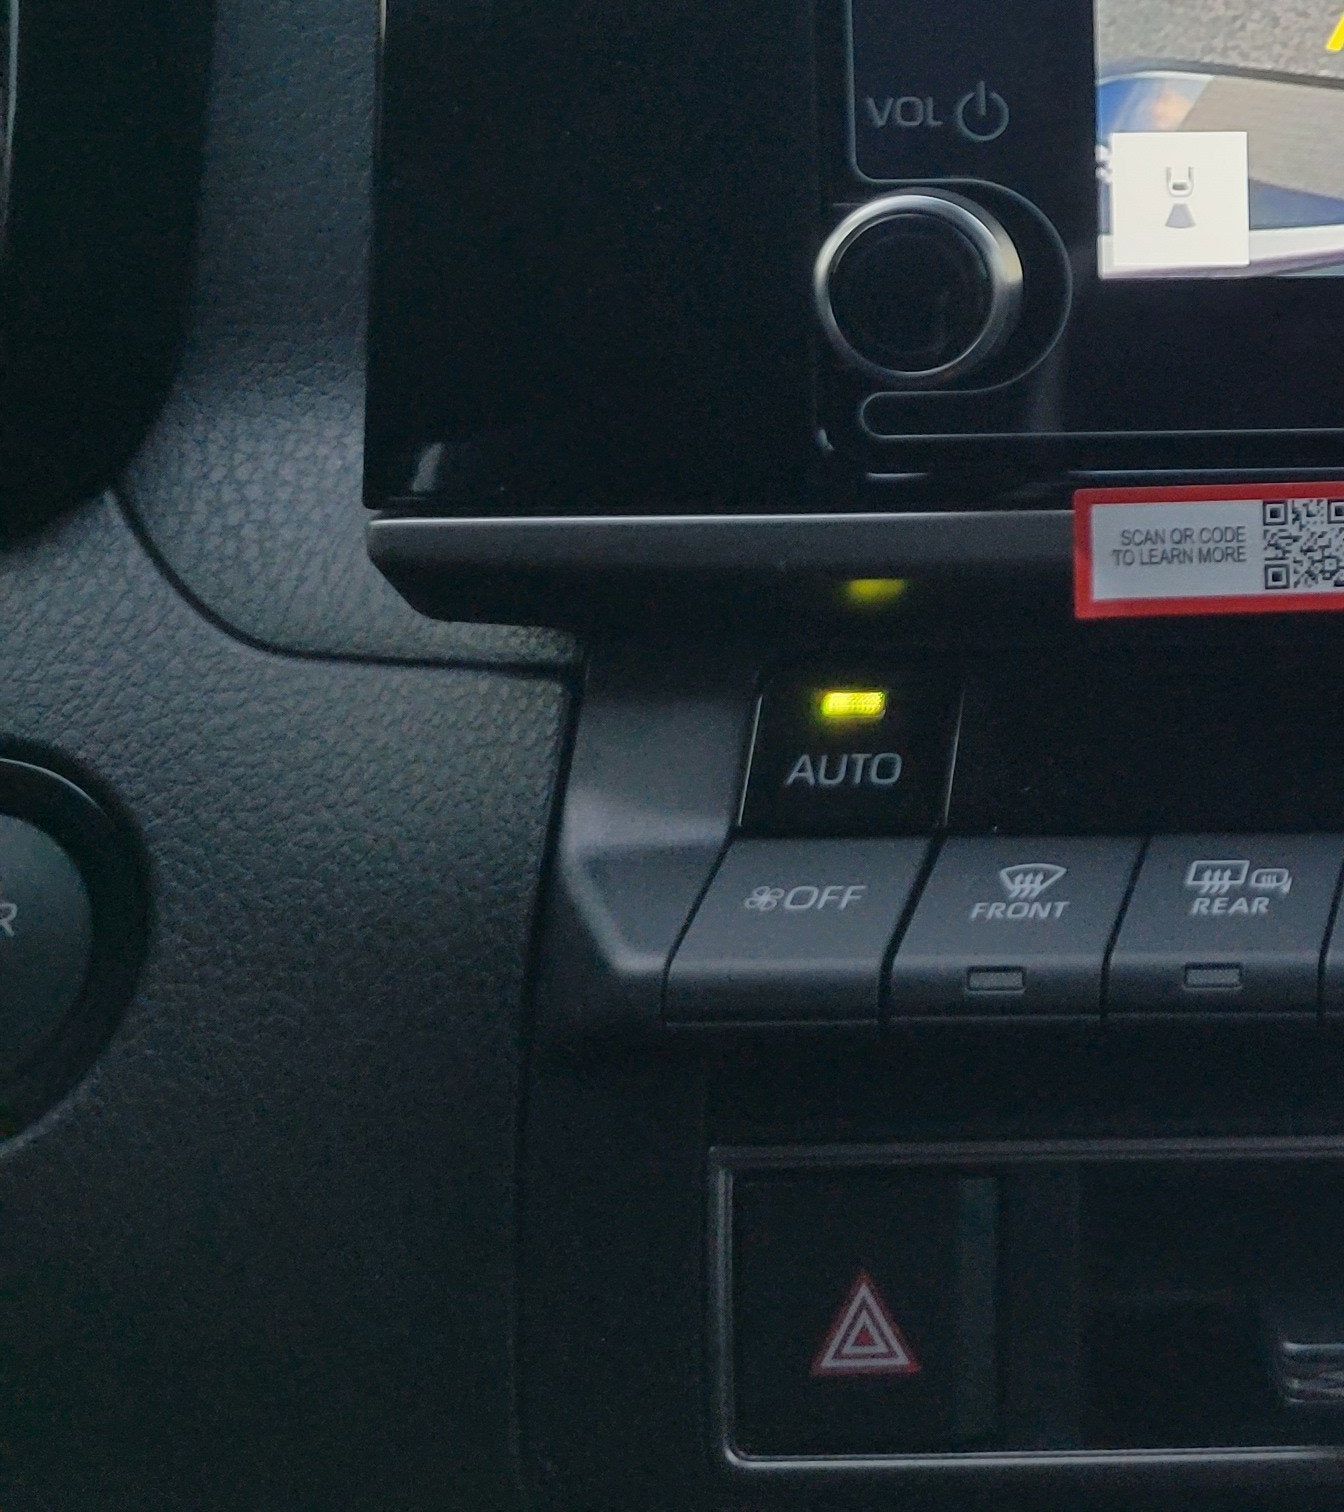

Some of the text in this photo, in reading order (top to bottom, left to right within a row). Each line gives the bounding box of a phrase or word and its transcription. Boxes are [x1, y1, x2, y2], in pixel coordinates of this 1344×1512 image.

[865, 96, 943, 128] VOL
[1121, 528, 1165, 546] SCAN
[1201, 526, 1247, 543] CODE
[1113, 546, 1247, 566] TO LEARN MORE
[786, 752, 902, 787] AUTO
[782, 886, 866, 911] OFF
[1191, 896, 1270, 917] REAR
[970, 900, 1070, 921] FRONT
